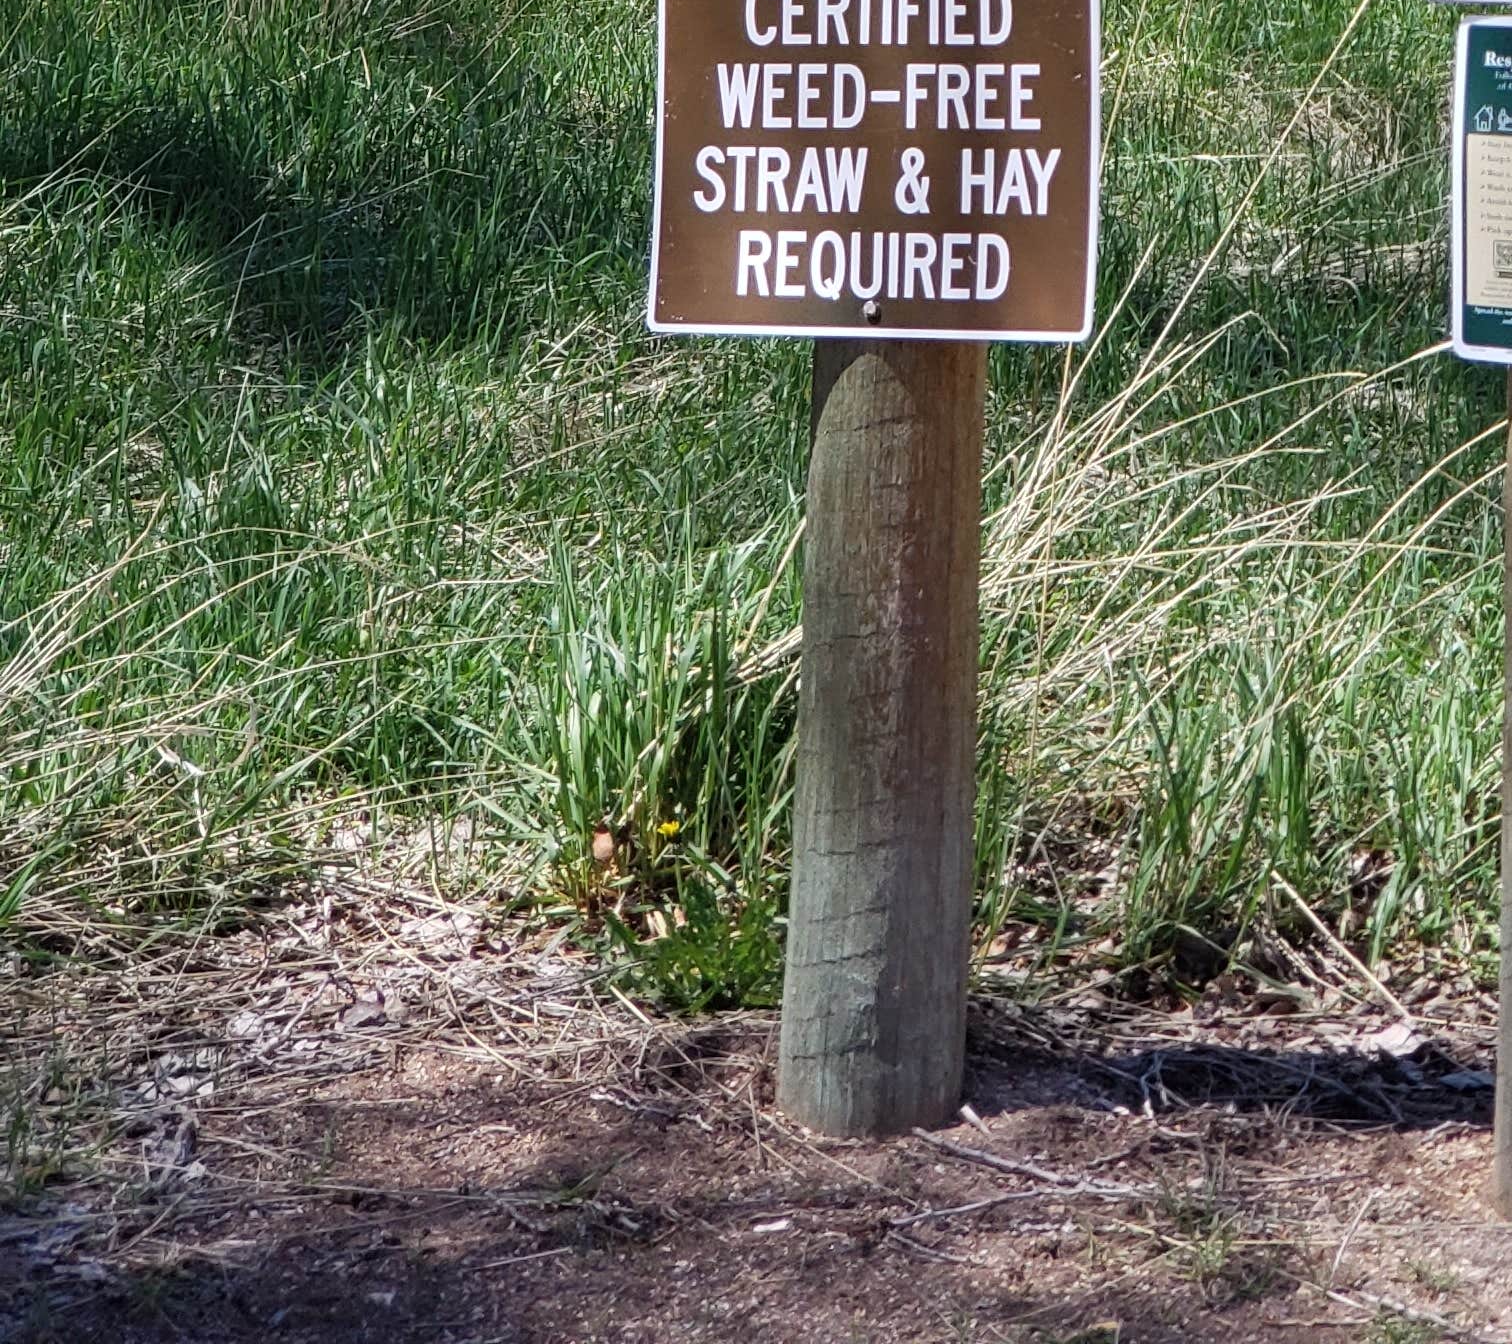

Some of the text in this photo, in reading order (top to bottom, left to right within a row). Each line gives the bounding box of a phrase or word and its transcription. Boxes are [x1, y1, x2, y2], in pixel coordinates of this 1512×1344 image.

[717, 63, 1042, 131] WEED-FREE
[693, 145, 1062, 216] STRAW & HAY
[735, 229, 1011, 301] REQUIRED
